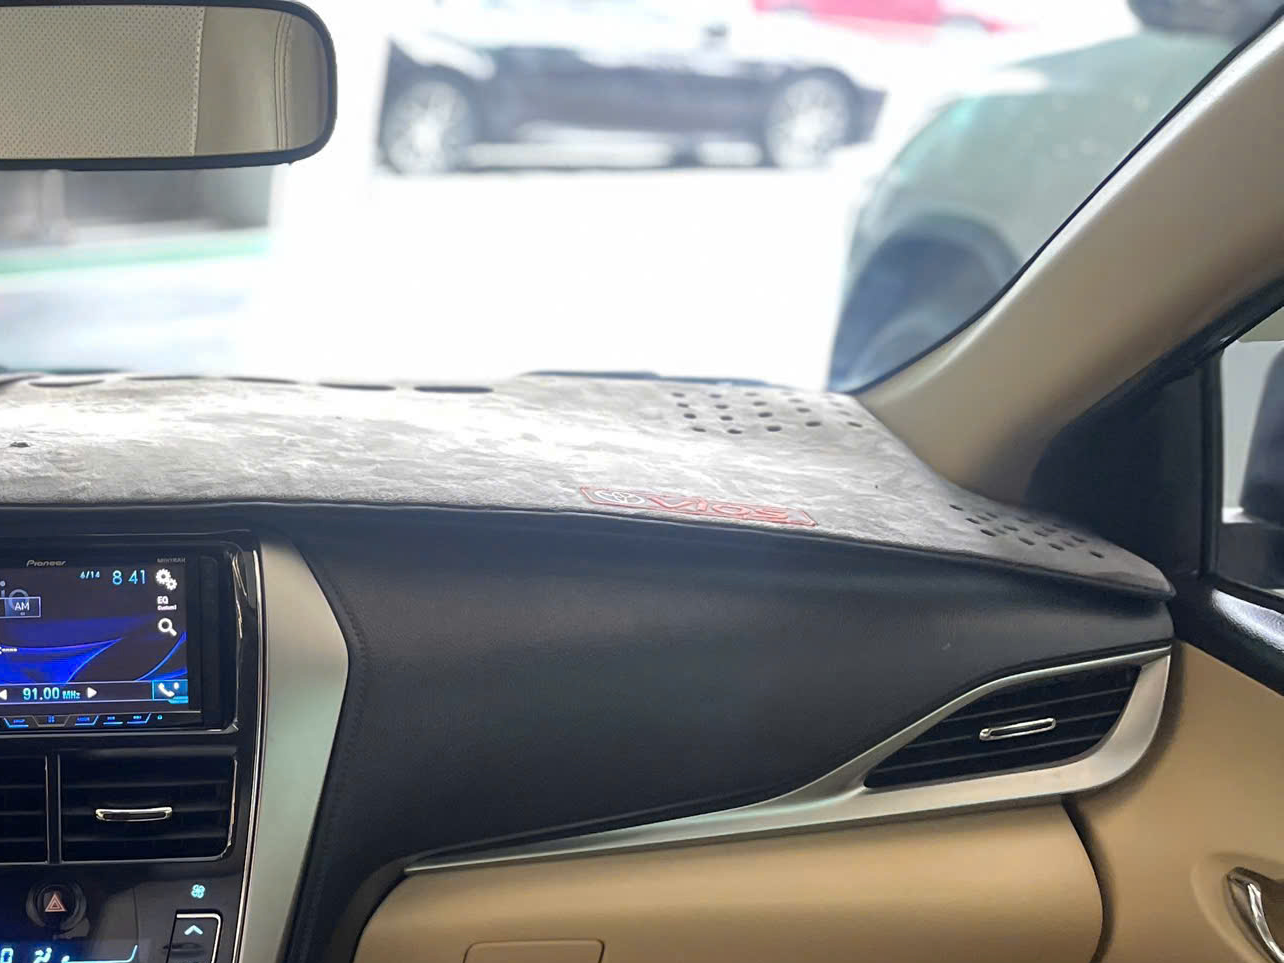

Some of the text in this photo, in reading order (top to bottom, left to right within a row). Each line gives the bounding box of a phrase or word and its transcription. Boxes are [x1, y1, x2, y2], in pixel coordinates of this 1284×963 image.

[26, 559, 66, 567] Pioneer
[157, 596, 169, 605] EQ
[15, 601, 30, 611] AM
[23, 687, 81, 701] 91.00 MHz
